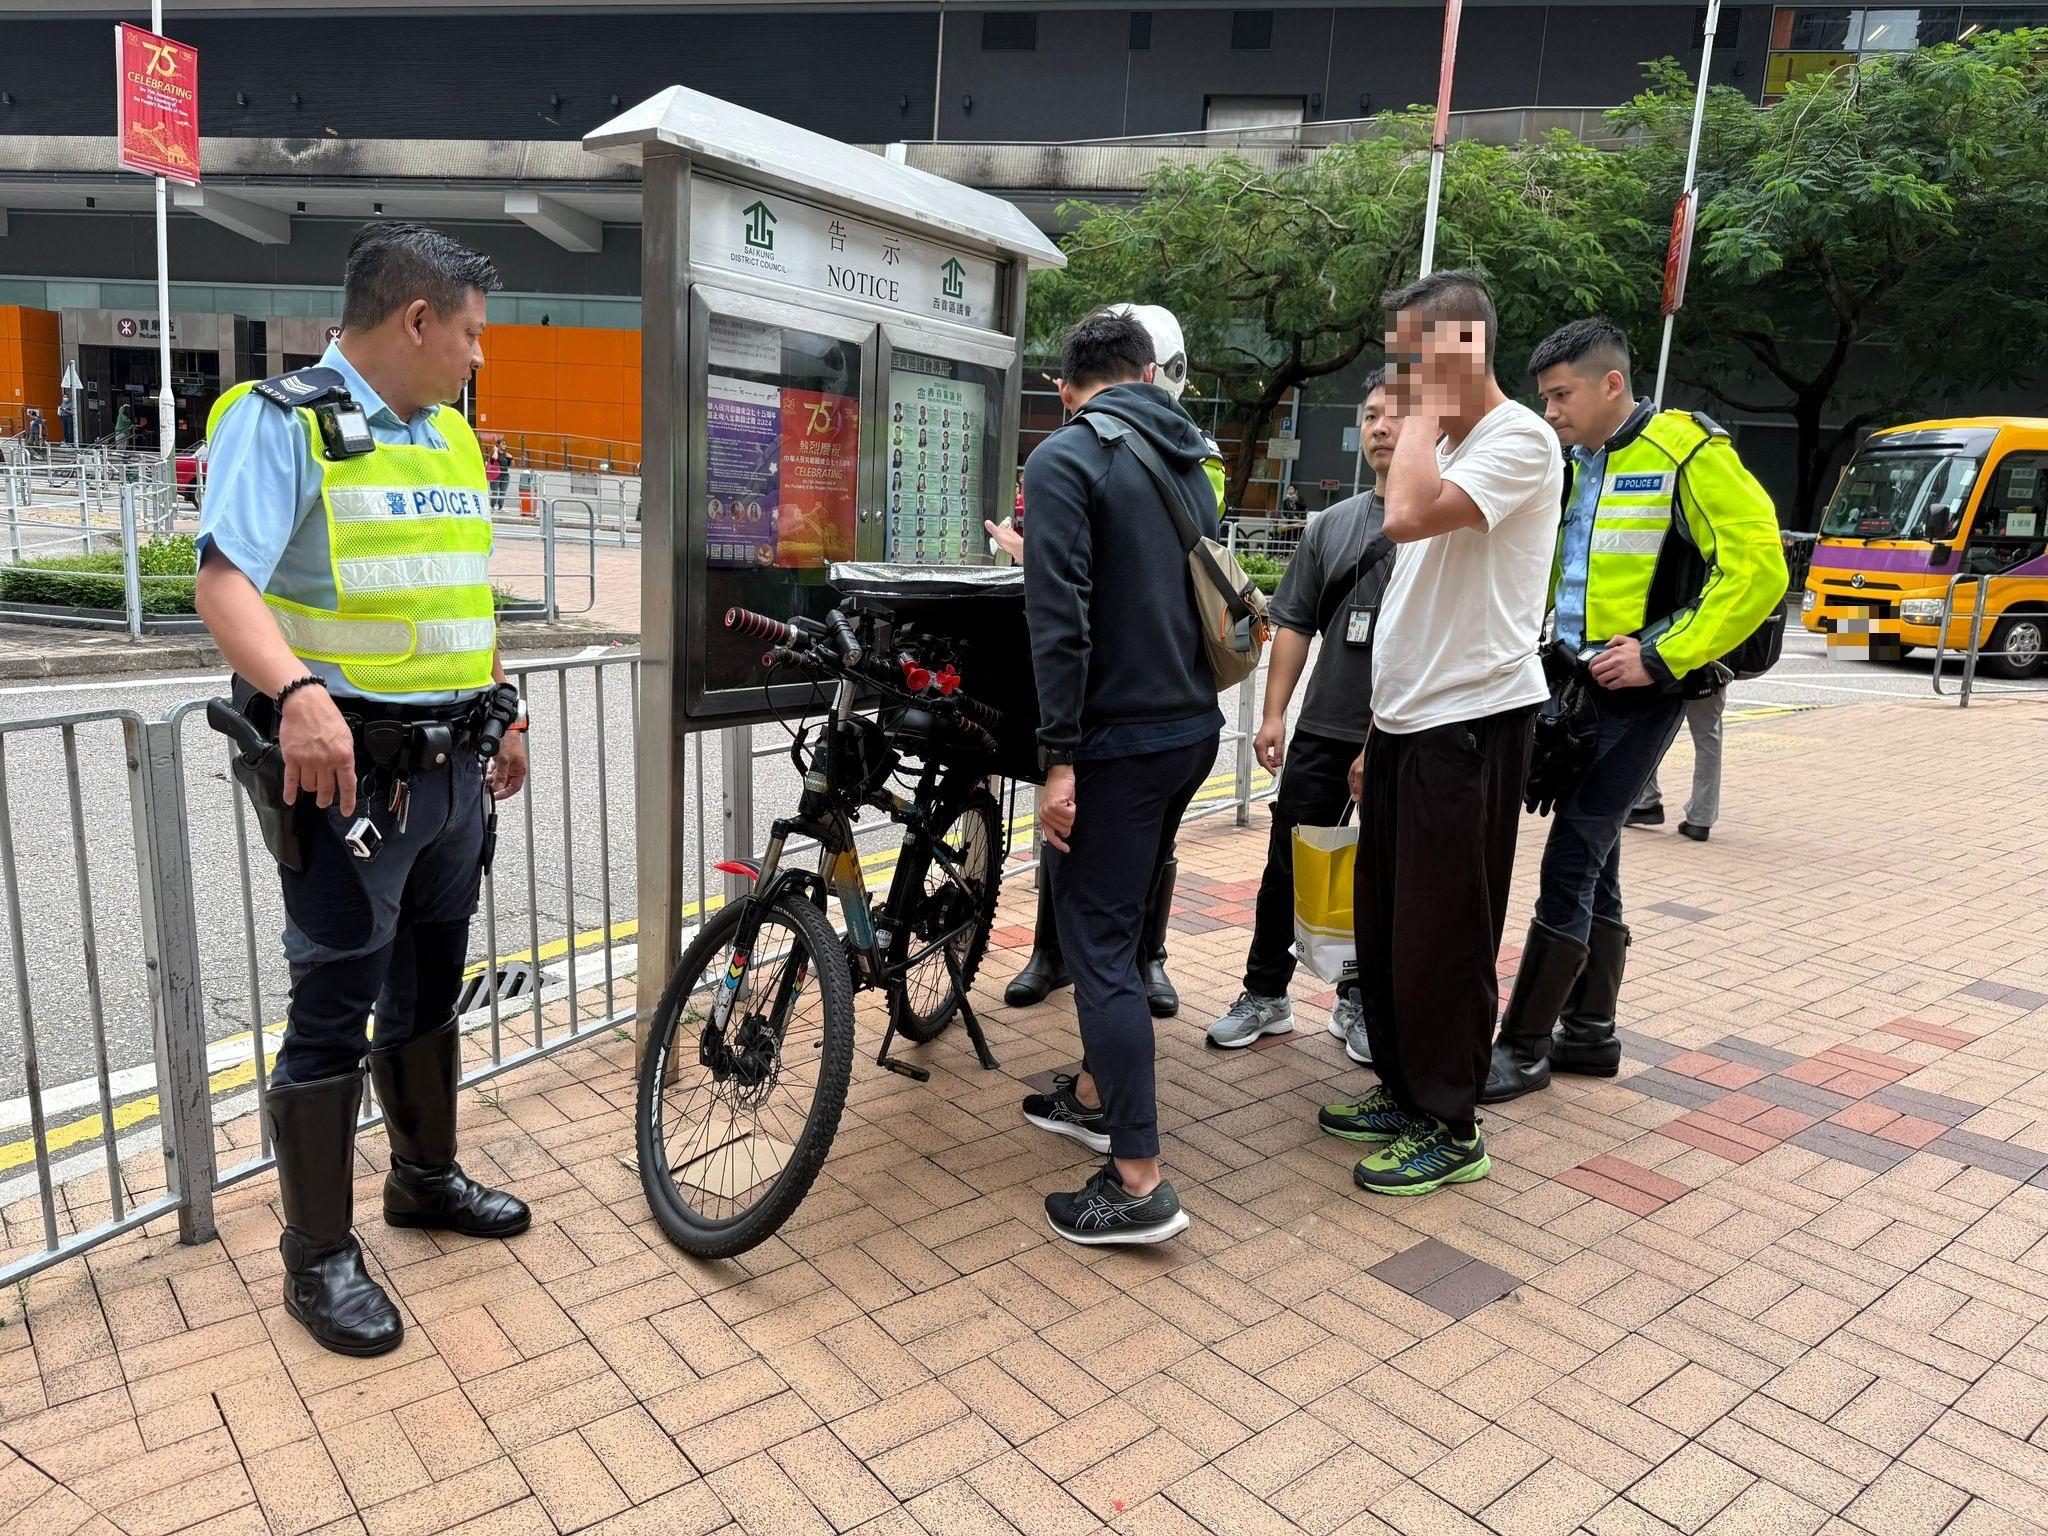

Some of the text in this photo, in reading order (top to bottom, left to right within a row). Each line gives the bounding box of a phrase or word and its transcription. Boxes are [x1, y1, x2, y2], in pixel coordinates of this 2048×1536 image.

[141, 41, 179, 78] 75
[127, 71, 192, 100] CELEBRATING
[730, 252, 787, 274] DISTRICT COUNCIL
[744, 246, 775, 261] SAI KUNG
[827, 264, 899, 303] NOTICE
[803, 400, 833, 436] 75
[794, 466, 843, 480] CELEBRATING
[1625, 479, 1651, 488] POLICE
[412, 489, 471, 515] POICE
